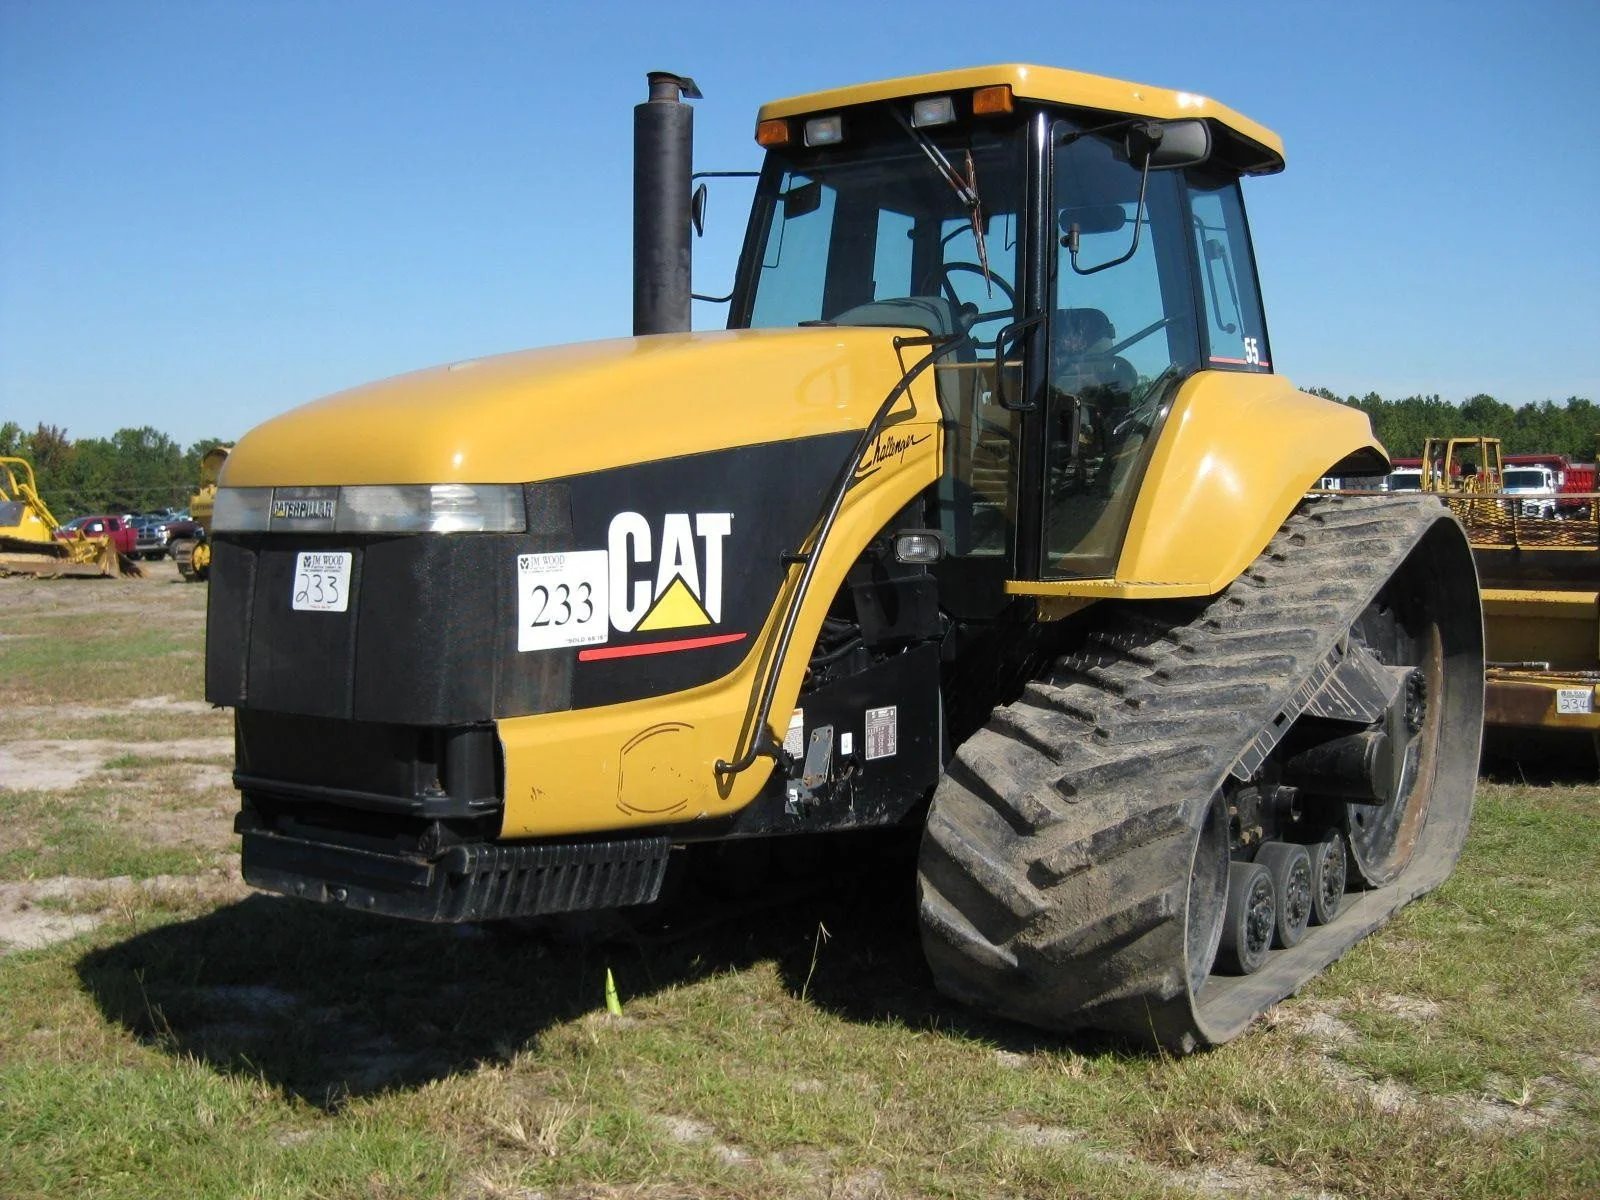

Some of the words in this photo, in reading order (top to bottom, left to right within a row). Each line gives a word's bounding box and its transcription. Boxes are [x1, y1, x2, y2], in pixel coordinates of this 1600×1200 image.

[1244, 337, 1259, 365] 55
[274, 500, 333, 519] CATERPILLAR
[323, 555, 344, 565] WOOD
[543, 554, 565, 566] WOOD
[608, 511, 732, 632] CAT
[296, 573, 339, 604] 233
[531, 582, 593, 628] 233
[1561, 698, 1589, 710] 234
